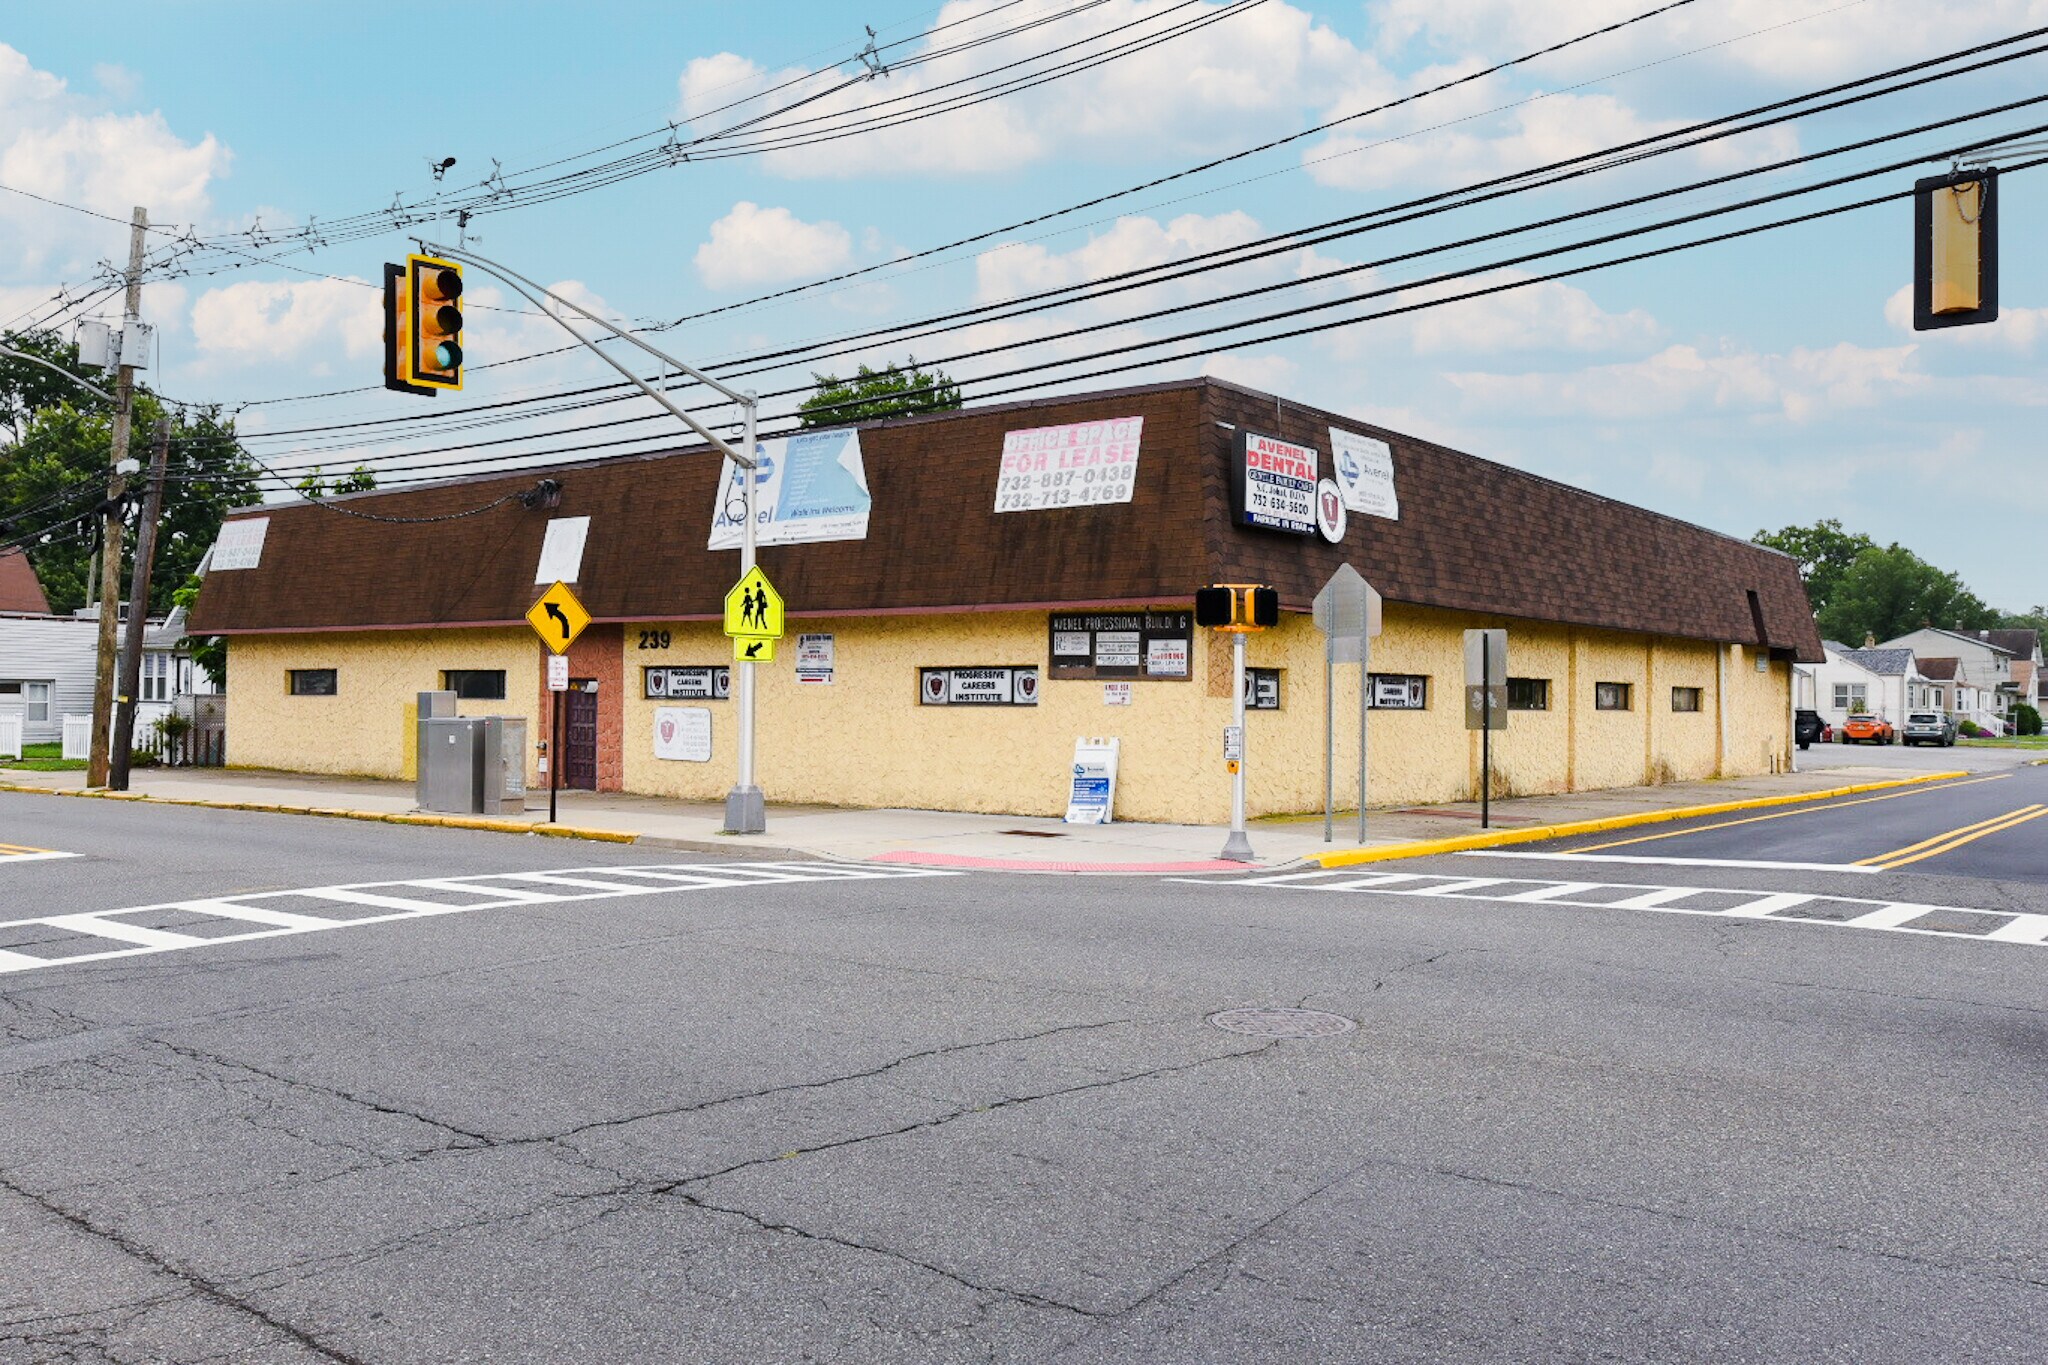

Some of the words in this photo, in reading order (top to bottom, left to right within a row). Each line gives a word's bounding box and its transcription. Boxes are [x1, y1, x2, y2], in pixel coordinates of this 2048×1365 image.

[1007, 428, 1071, 450] OFFICE
[1077, 420, 1140, 444] SPACE
[1003, 453, 1048, 473] FOR
[1059, 443, 1136, 468] LEASE
[1258, 439, 1307, 461] AVENEL
[1247, 451, 1316, 481] DENTAL
[1001, 465, 1132, 492] 732-887-0438
[1001, 484, 1127, 509] 732-713-4769
[1253, 493, 1267, 507] 732
[715, 506, 773, 528] Aveel
[1253, 513, 1281, 527] PARKING
[1281, 519, 1290, 528] IN
[1054, 618, 1083, 630] AVENEL
[1085, 617, 1141, 630] PROFESSIONAL
[639, 630, 671, 649] 239
[954, 671, 1004, 680] PROGRESSIVE
[961, 681, 996, 690] CAREERS
[955, 693, 1003, 701] INSTITUTE
